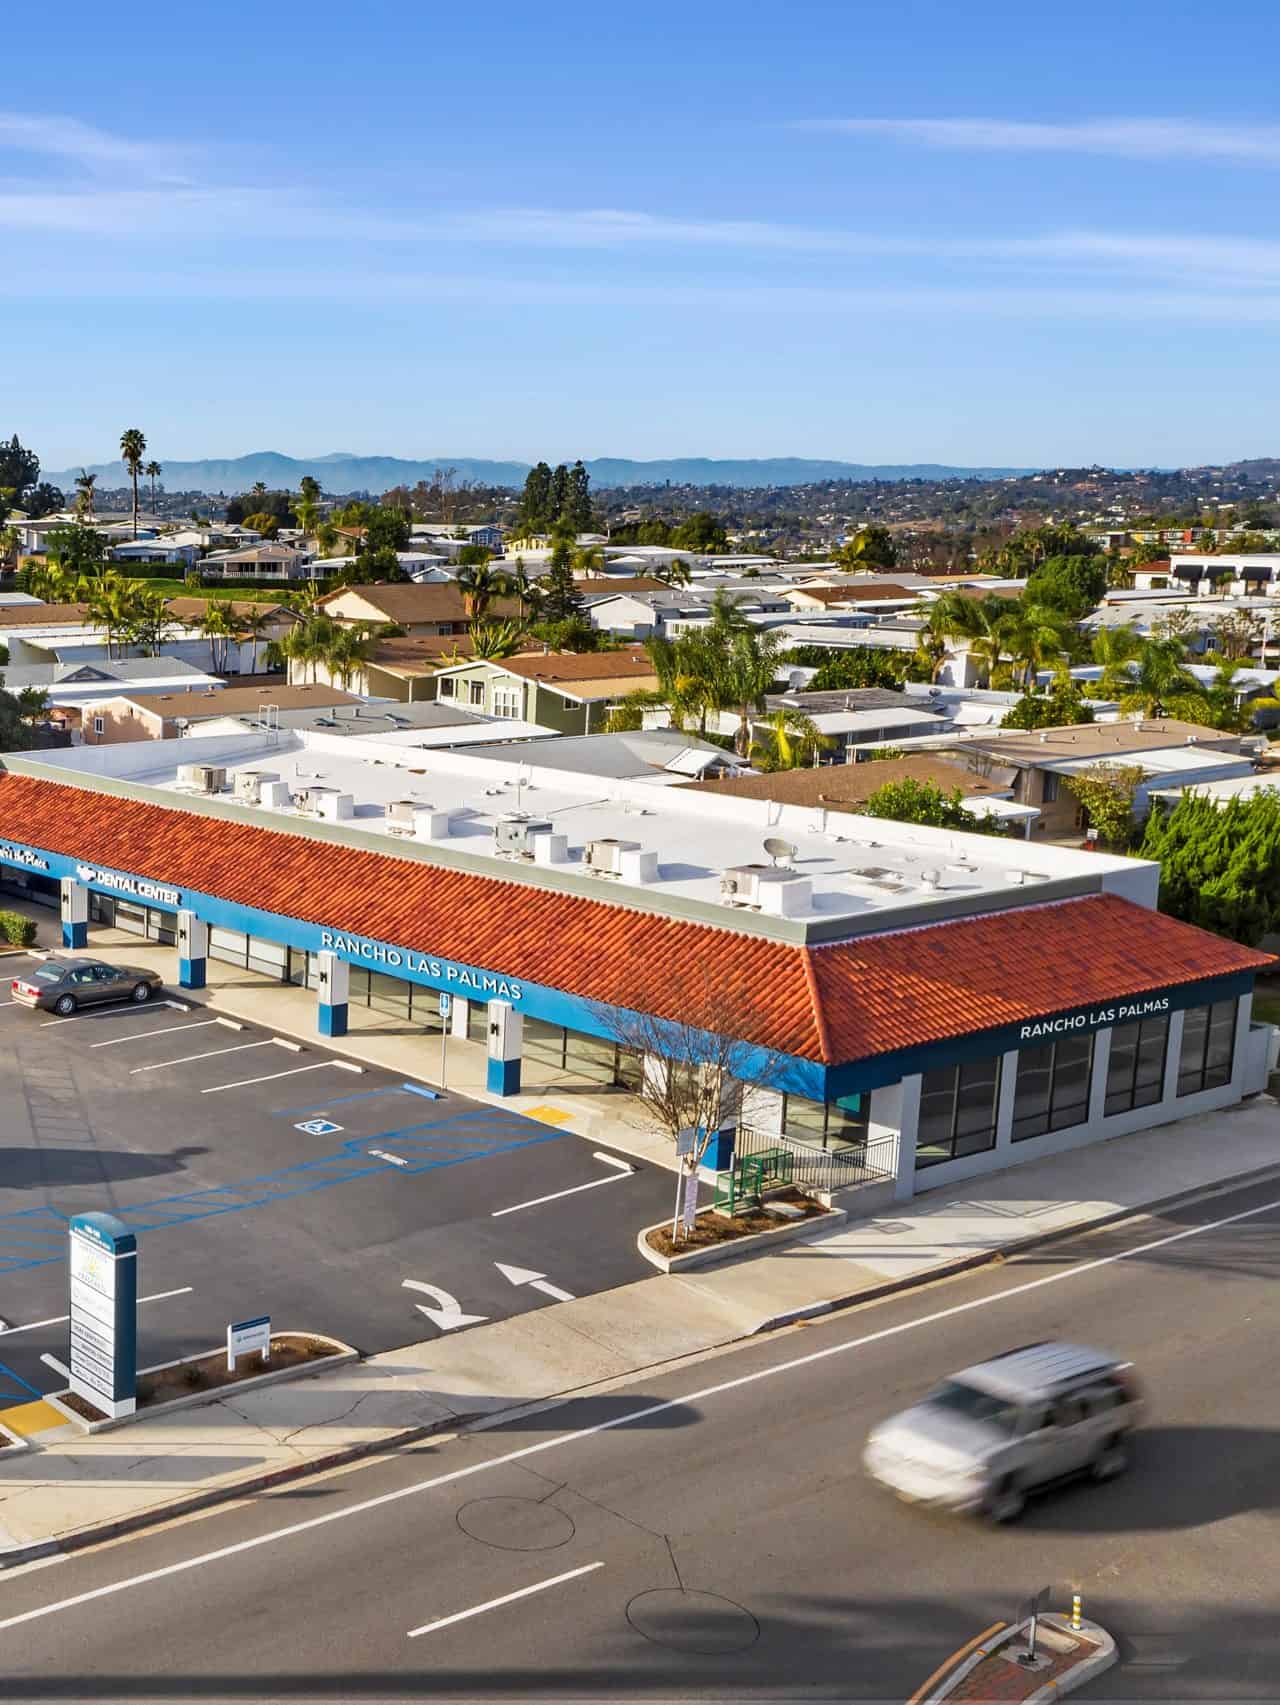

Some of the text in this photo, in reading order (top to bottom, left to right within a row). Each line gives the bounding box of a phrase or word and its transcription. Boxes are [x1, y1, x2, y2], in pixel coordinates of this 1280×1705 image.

[97, 871, 178, 905] DENTAL CENTER
[321, 932, 522, 999] RANCHO LAS PALMAS
[1020, 998, 1169, 1040] RANCHO LAS PALMAS
